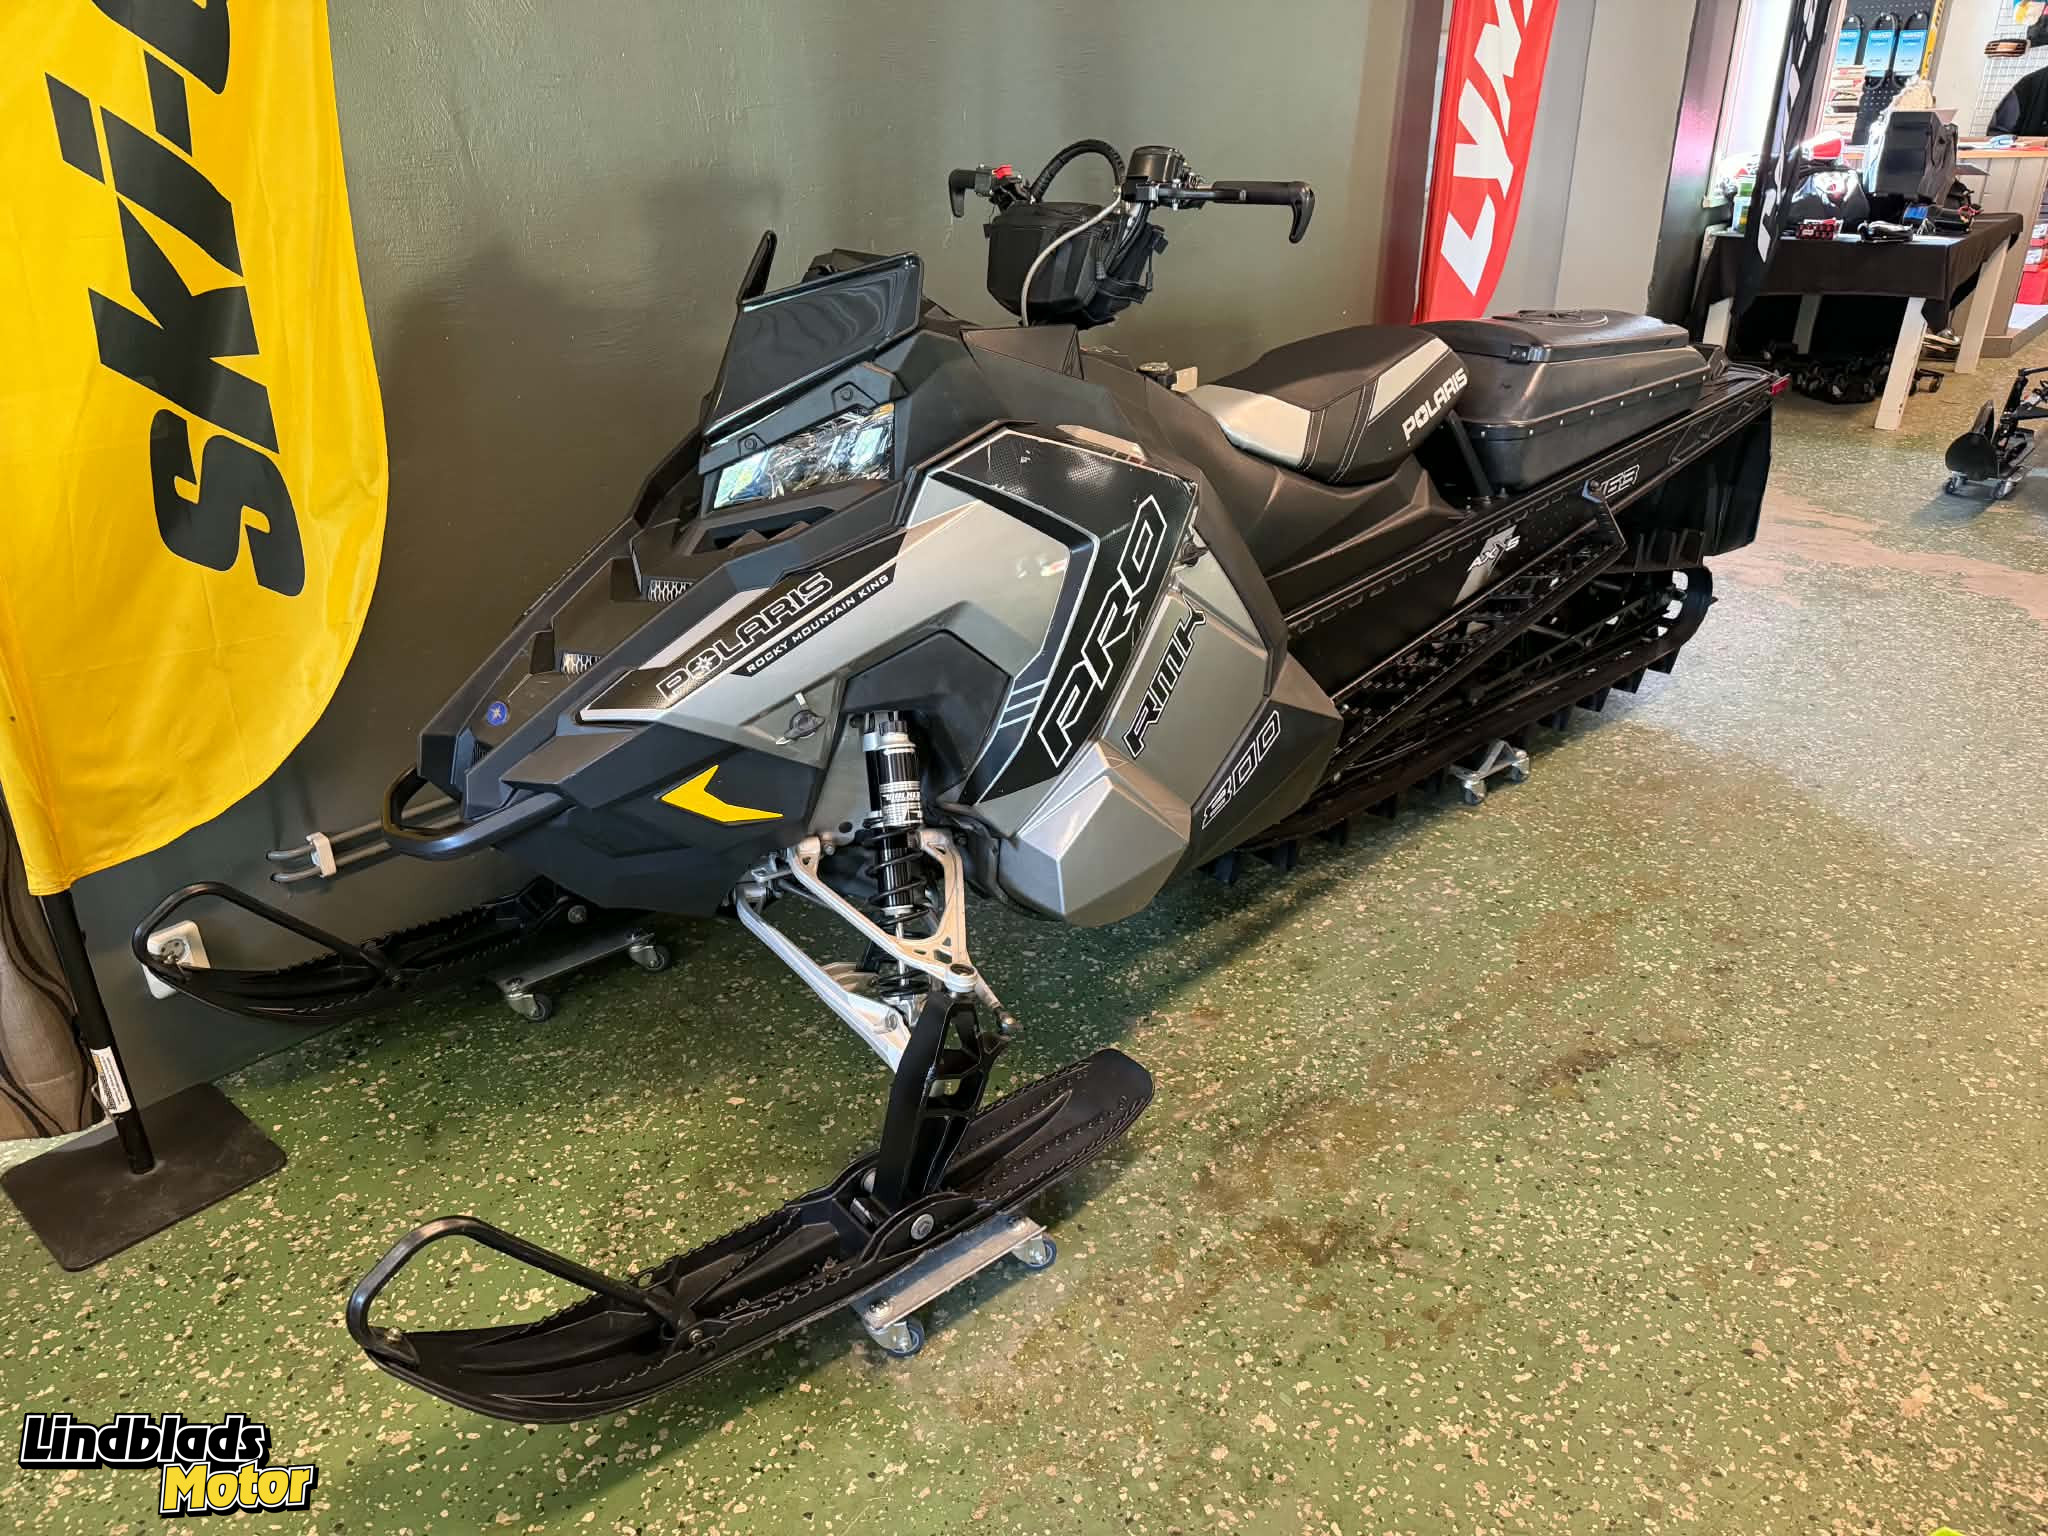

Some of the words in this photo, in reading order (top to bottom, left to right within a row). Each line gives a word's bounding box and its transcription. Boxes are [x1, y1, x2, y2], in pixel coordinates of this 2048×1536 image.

[1401, 367, 1468, 441] POLARIS
[656, 571, 834, 701] POLARIS
[746, 641, 789, 673] ROCKY
[792, 597, 856, 643] MOUNTAIN
[858, 574, 890, 599] KING
[1038, 494, 1168, 768] PRO
[1122, 593, 1207, 760] RMK
[1201, 709, 1281, 830] 800
